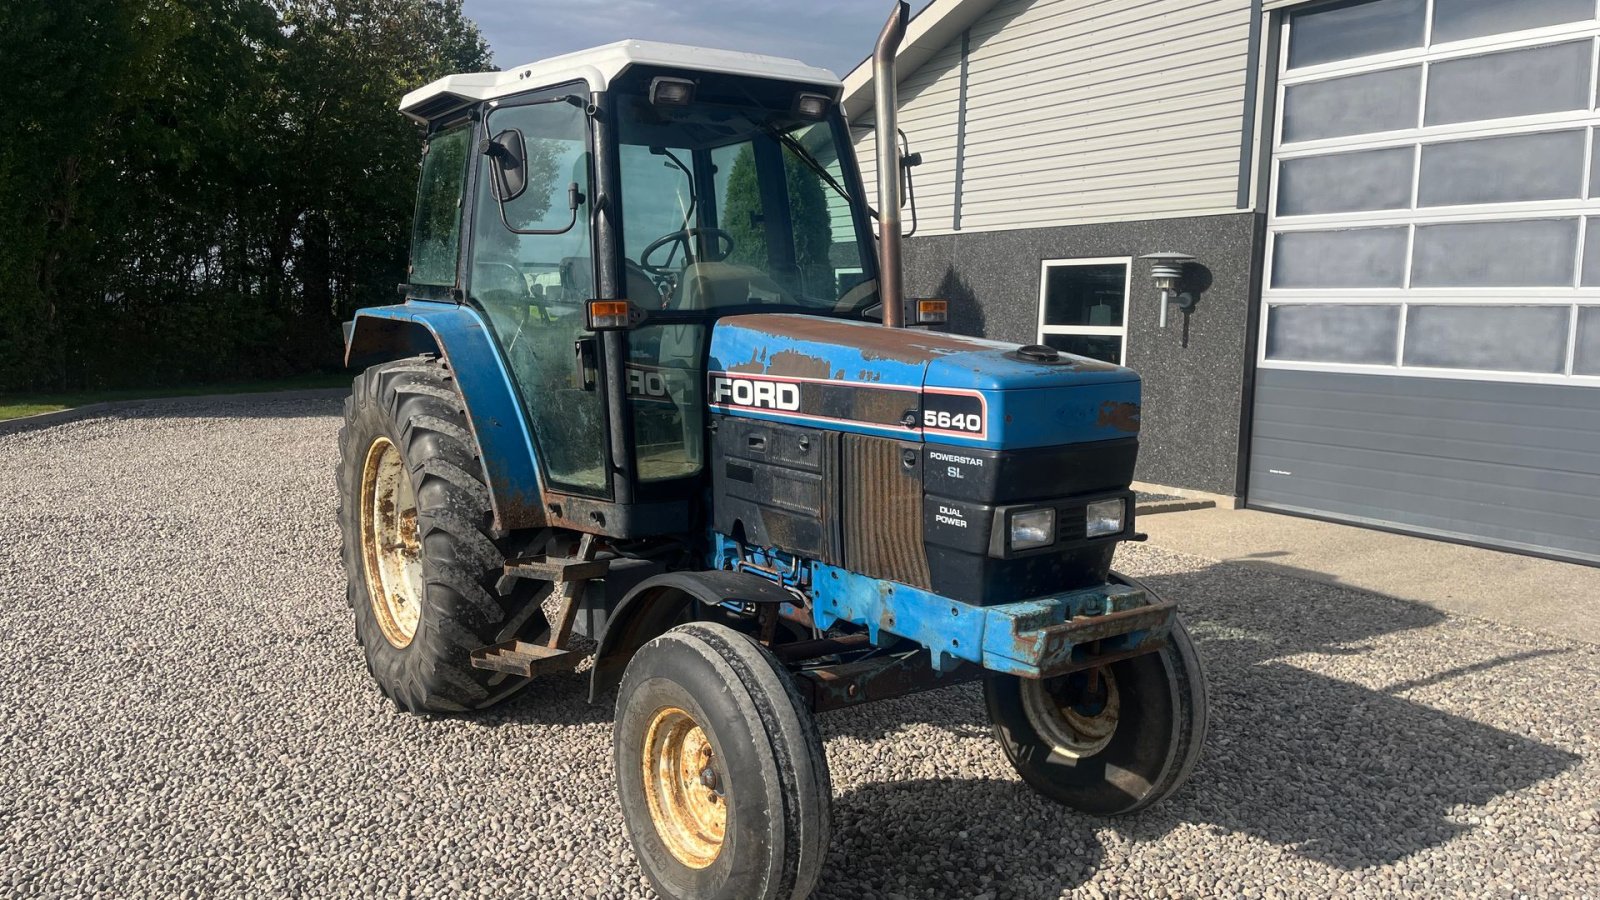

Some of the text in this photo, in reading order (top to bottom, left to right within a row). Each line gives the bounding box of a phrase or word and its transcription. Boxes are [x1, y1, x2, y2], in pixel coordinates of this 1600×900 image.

[715, 378, 800, 411] FORD
[924, 410, 981, 431] 5640
[930, 452, 983, 467] POWERSTAR
[947, 466, 965, 479] SL
[940, 506, 963, 518] DUAL
[935, 515, 967, 528] POWER
